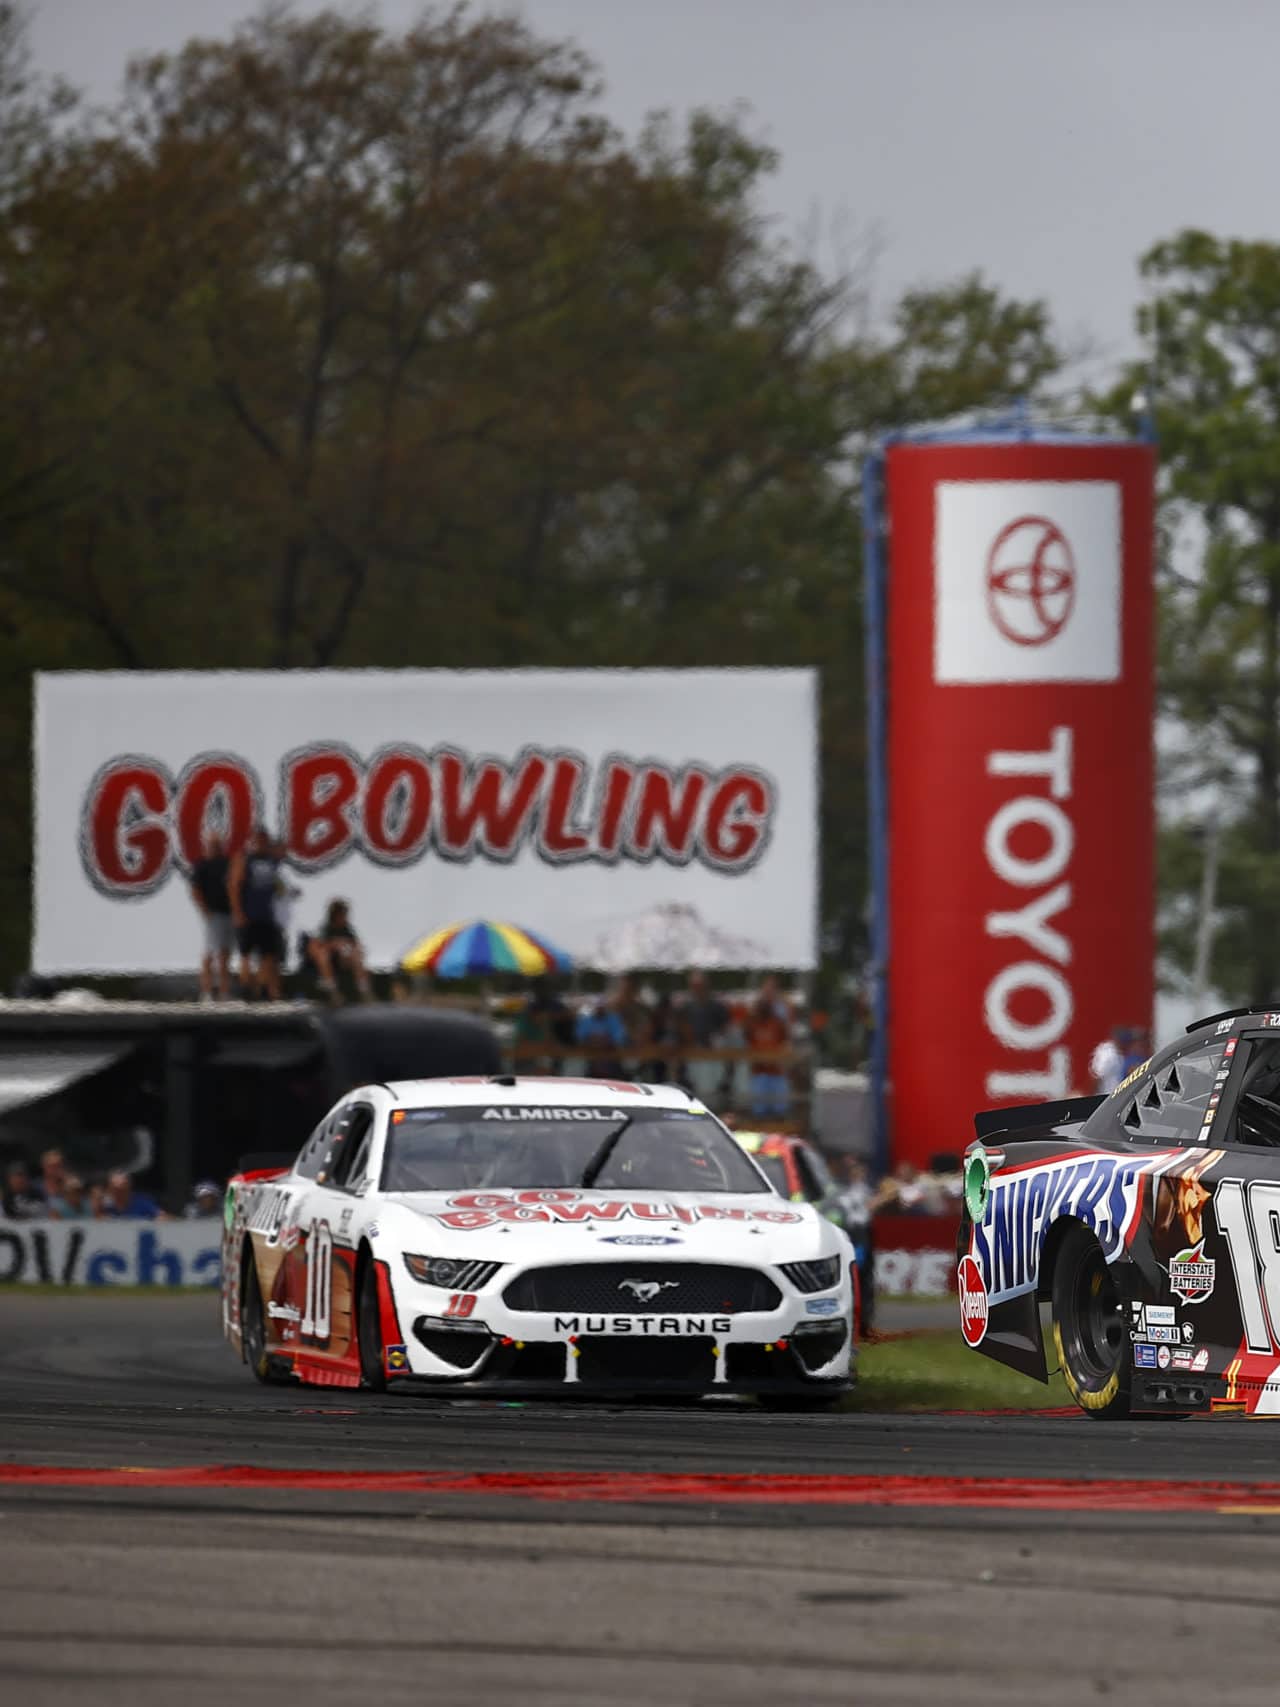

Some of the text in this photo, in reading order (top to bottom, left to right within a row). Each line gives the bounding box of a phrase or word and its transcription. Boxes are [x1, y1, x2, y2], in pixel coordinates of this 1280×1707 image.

[84, 743, 773, 895] GO BOWLING
[481, 1107, 630, 1121] ALMIROLA
[446, 1189, 583, 1210] GO
[430, 1201, 804, 1232] BOWLING
[973, 1159, 1155, 1295] SNICKERS
[301, 1217, 333, 1339] 10
[1171, 1263, 1214, 1276] INTERSTATE
[1173, 1277, 1212, 1289] BATTERIES
[446, 1294, 477, 1318] 10
[958, 1260, 988, 1332] Rheem
[554, 1317, 732, 1333] MUSTANG
[1148, 1327, 1170, 1339] Mobil
